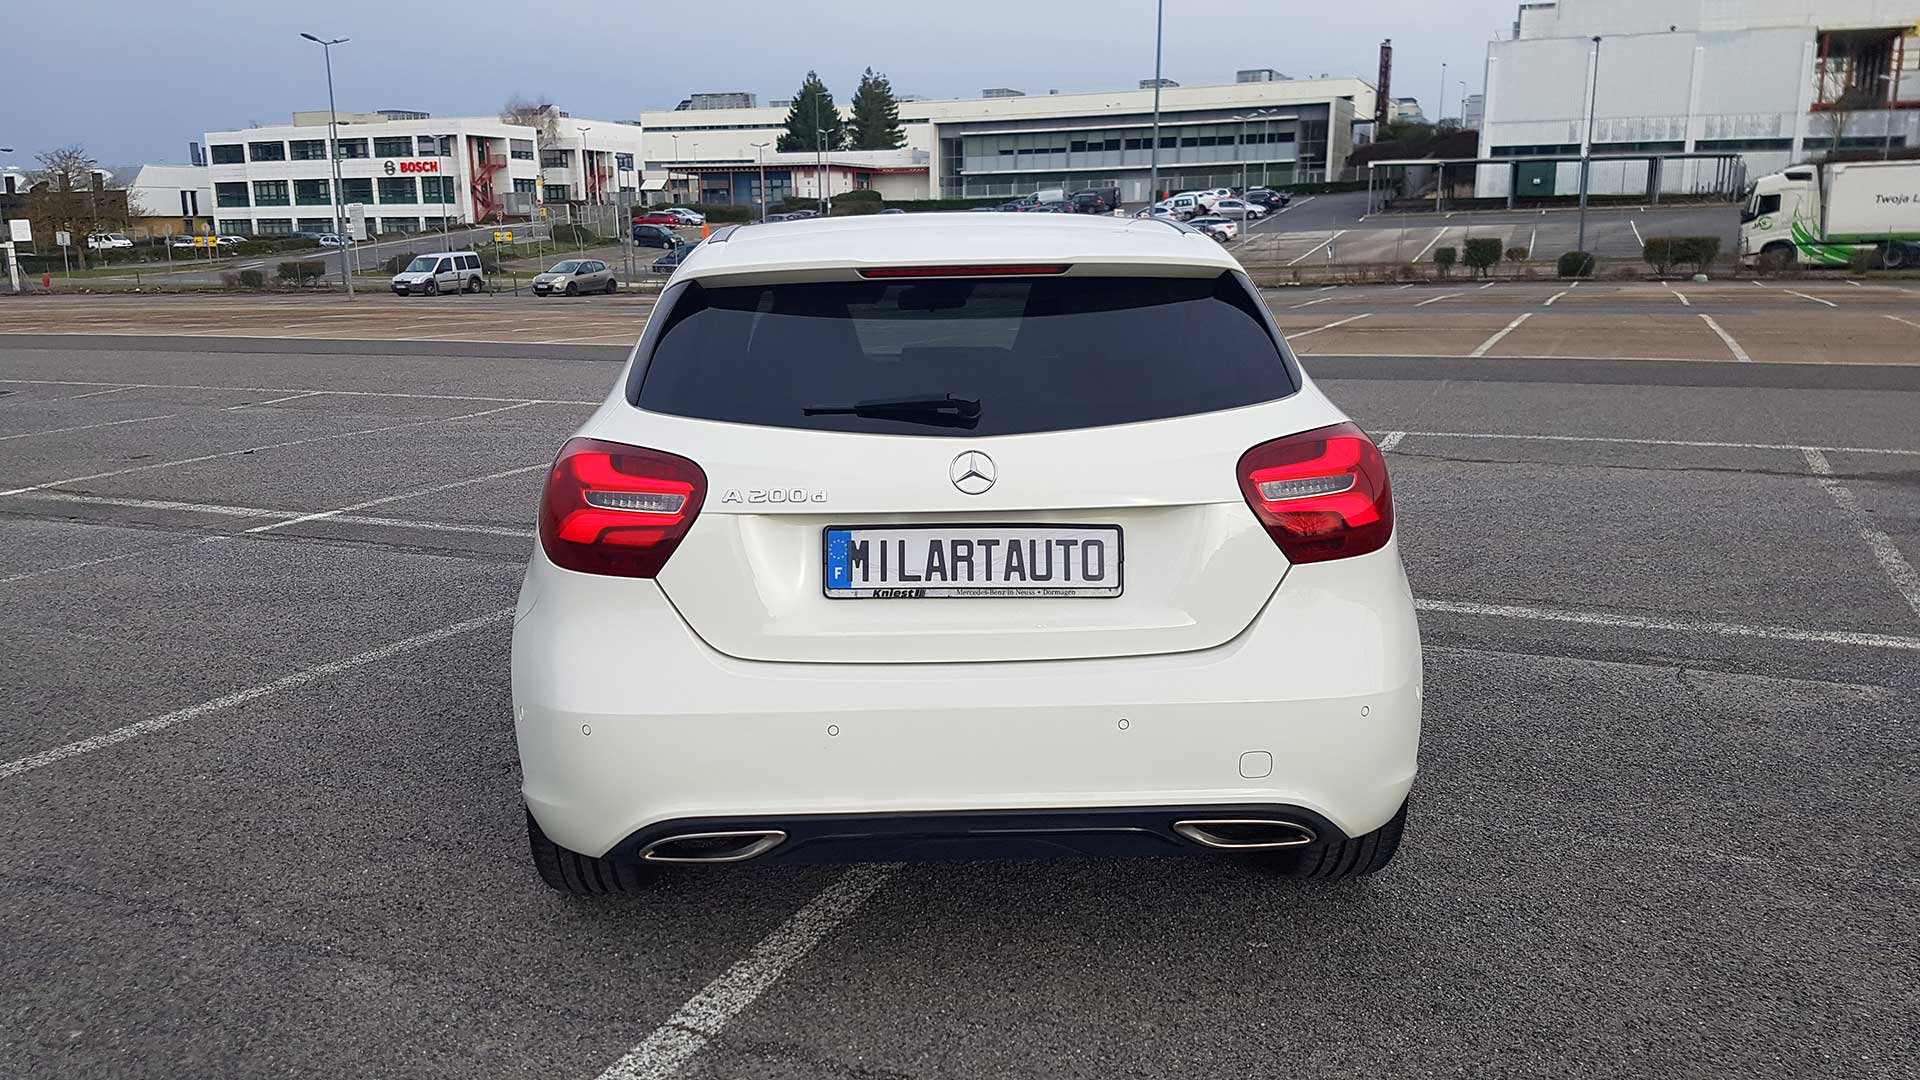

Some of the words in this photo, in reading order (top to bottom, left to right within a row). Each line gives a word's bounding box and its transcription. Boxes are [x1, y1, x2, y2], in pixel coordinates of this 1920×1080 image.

[400, 161, 438, 173] BOSCH
[1875, 194, 1909, 205] Twoja
[721, 488, 743, 503] A
[834, 567, 842, 579] F
[848, 539, 1105, 582] MILARTAUTO
